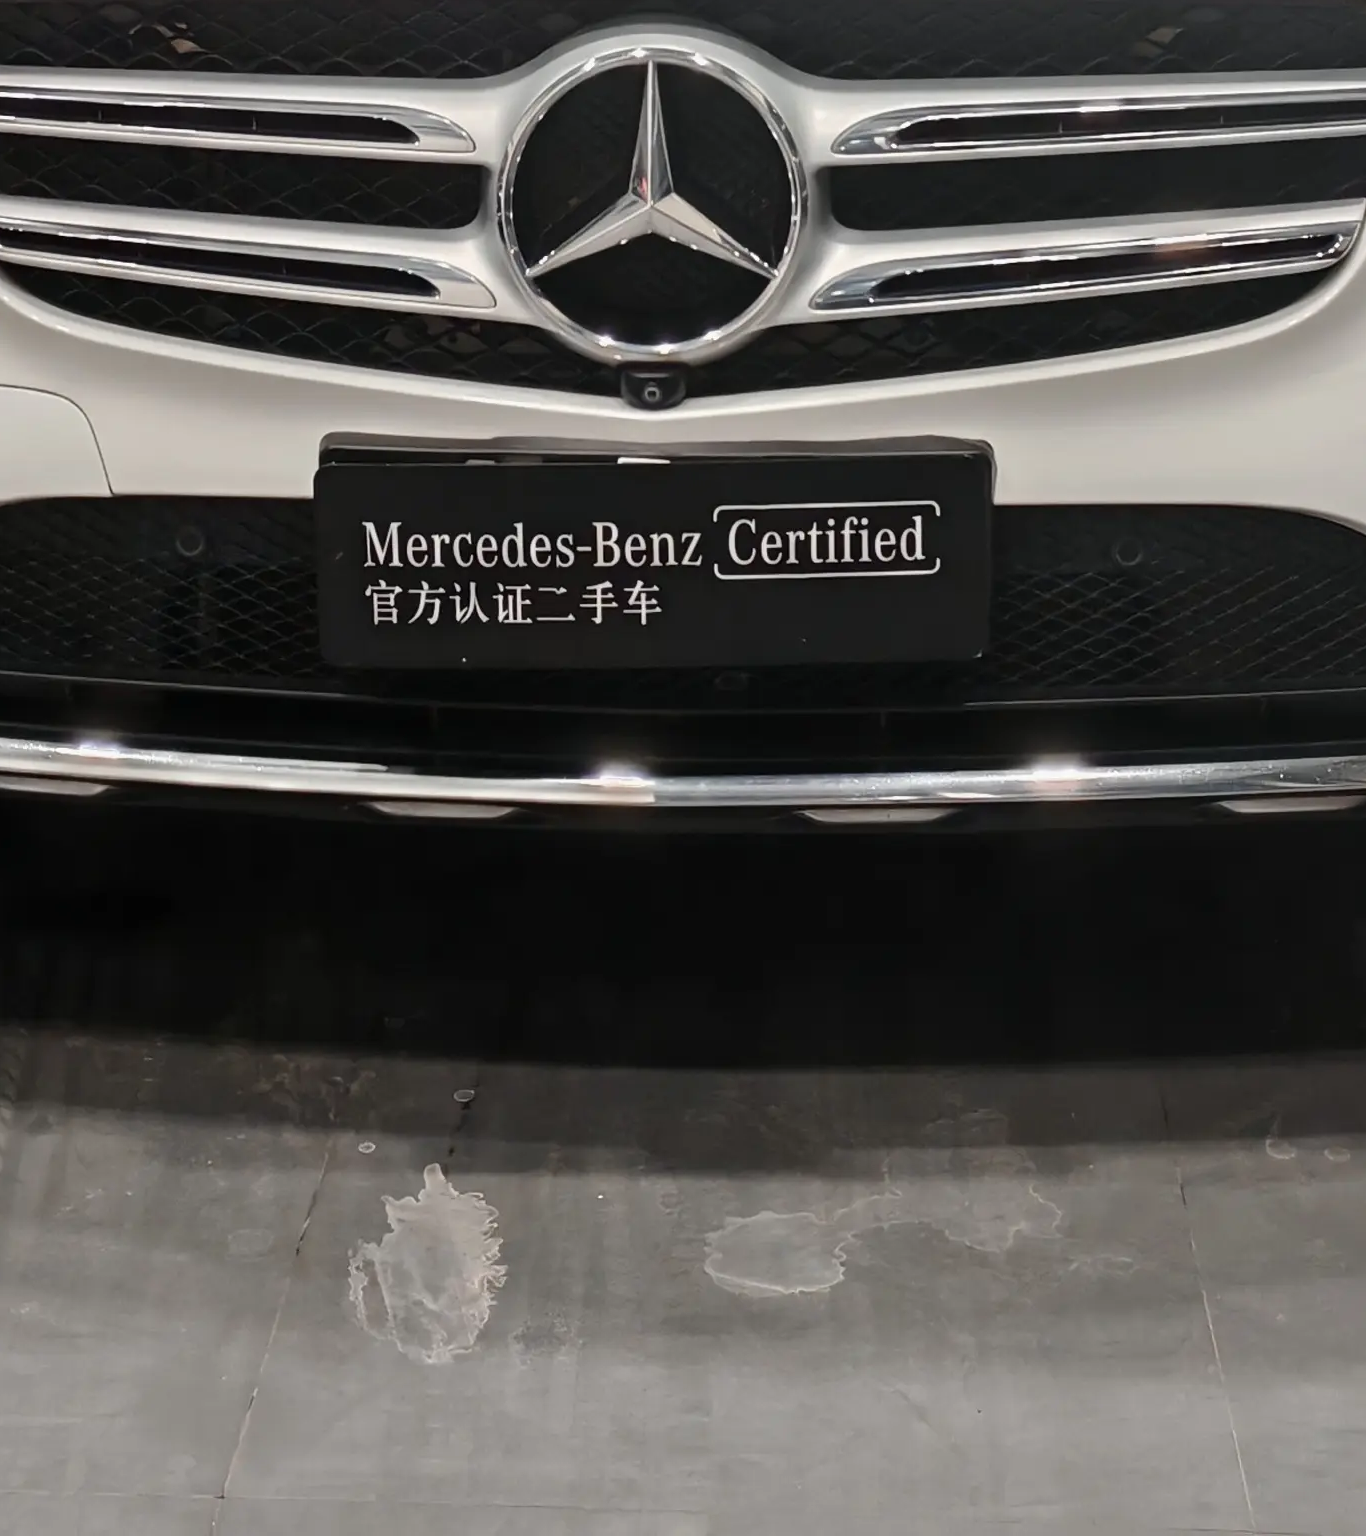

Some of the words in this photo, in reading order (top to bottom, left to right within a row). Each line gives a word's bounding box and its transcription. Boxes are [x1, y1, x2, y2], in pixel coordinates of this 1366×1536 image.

[362, 522, 702, 567] Mercedes-Benz
[729, 516, 925, 565] Certified
[365, 580, 661, 625] 官方认证二手车
